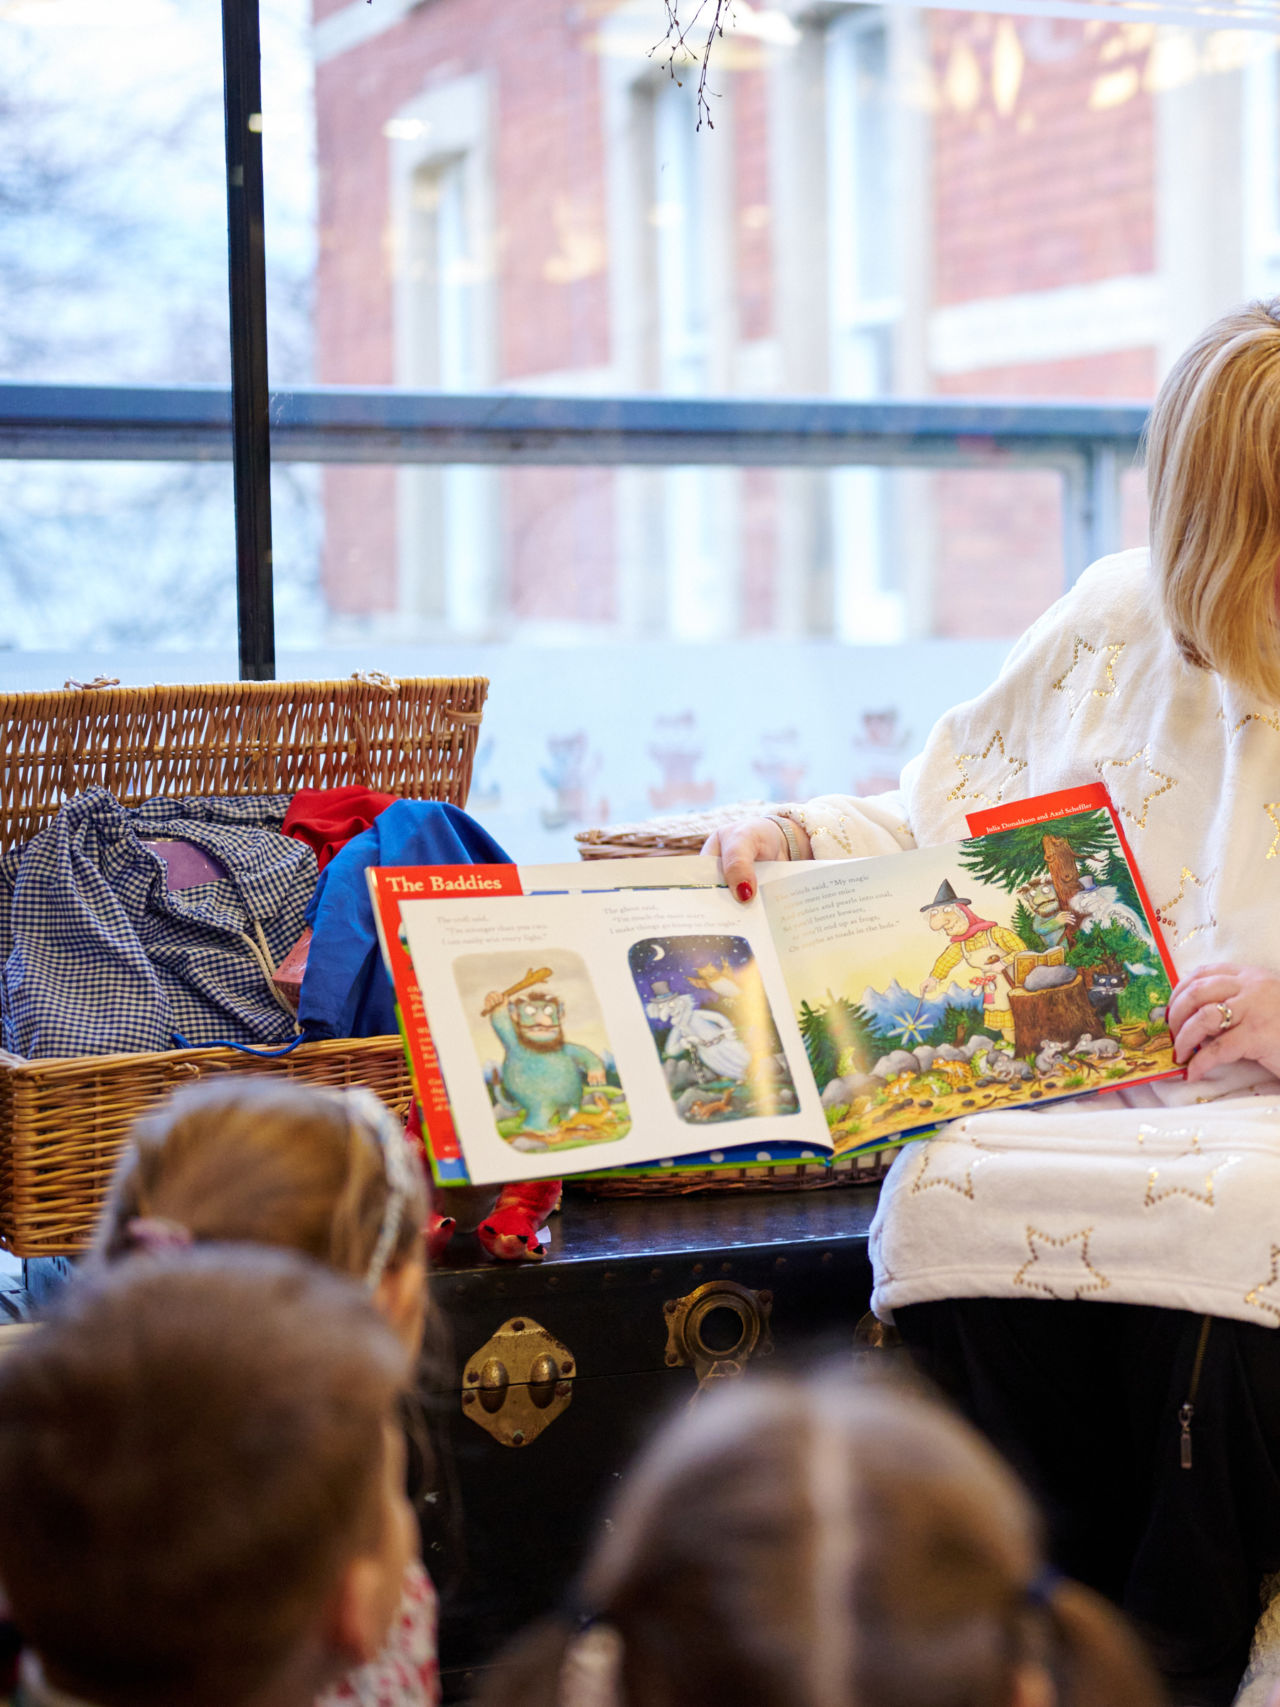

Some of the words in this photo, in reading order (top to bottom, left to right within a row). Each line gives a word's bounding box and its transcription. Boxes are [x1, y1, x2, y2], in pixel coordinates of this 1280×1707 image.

[985, 826, 1000, 834] Julia
[1001, 817, 1036, 829] Donaldson
[1037, 813, 1048, 821] and
[1050, 809, 1064, 818] Axel
[1065, 803, 1092, 814] Scheffler
[385, 876, 424, 892] The
[429, 874, 503, 891] Baddies
[790, 887, 810, 897] witch
[848, 875, 870, 885] magic
[822, 891, 838, 900] into
[838, 888, 856, 896] mice
[821, 901, 834, 910] and
[836, 898, 858, 909] pearls
[859, 895, 874, 903] into
[814, 912, 836, 922] better
[824, 922, 837, 932] end
[838, 920, 849, 928] up
[836, 930, 855, 940] toads
[865, 924, 878, 932] the
